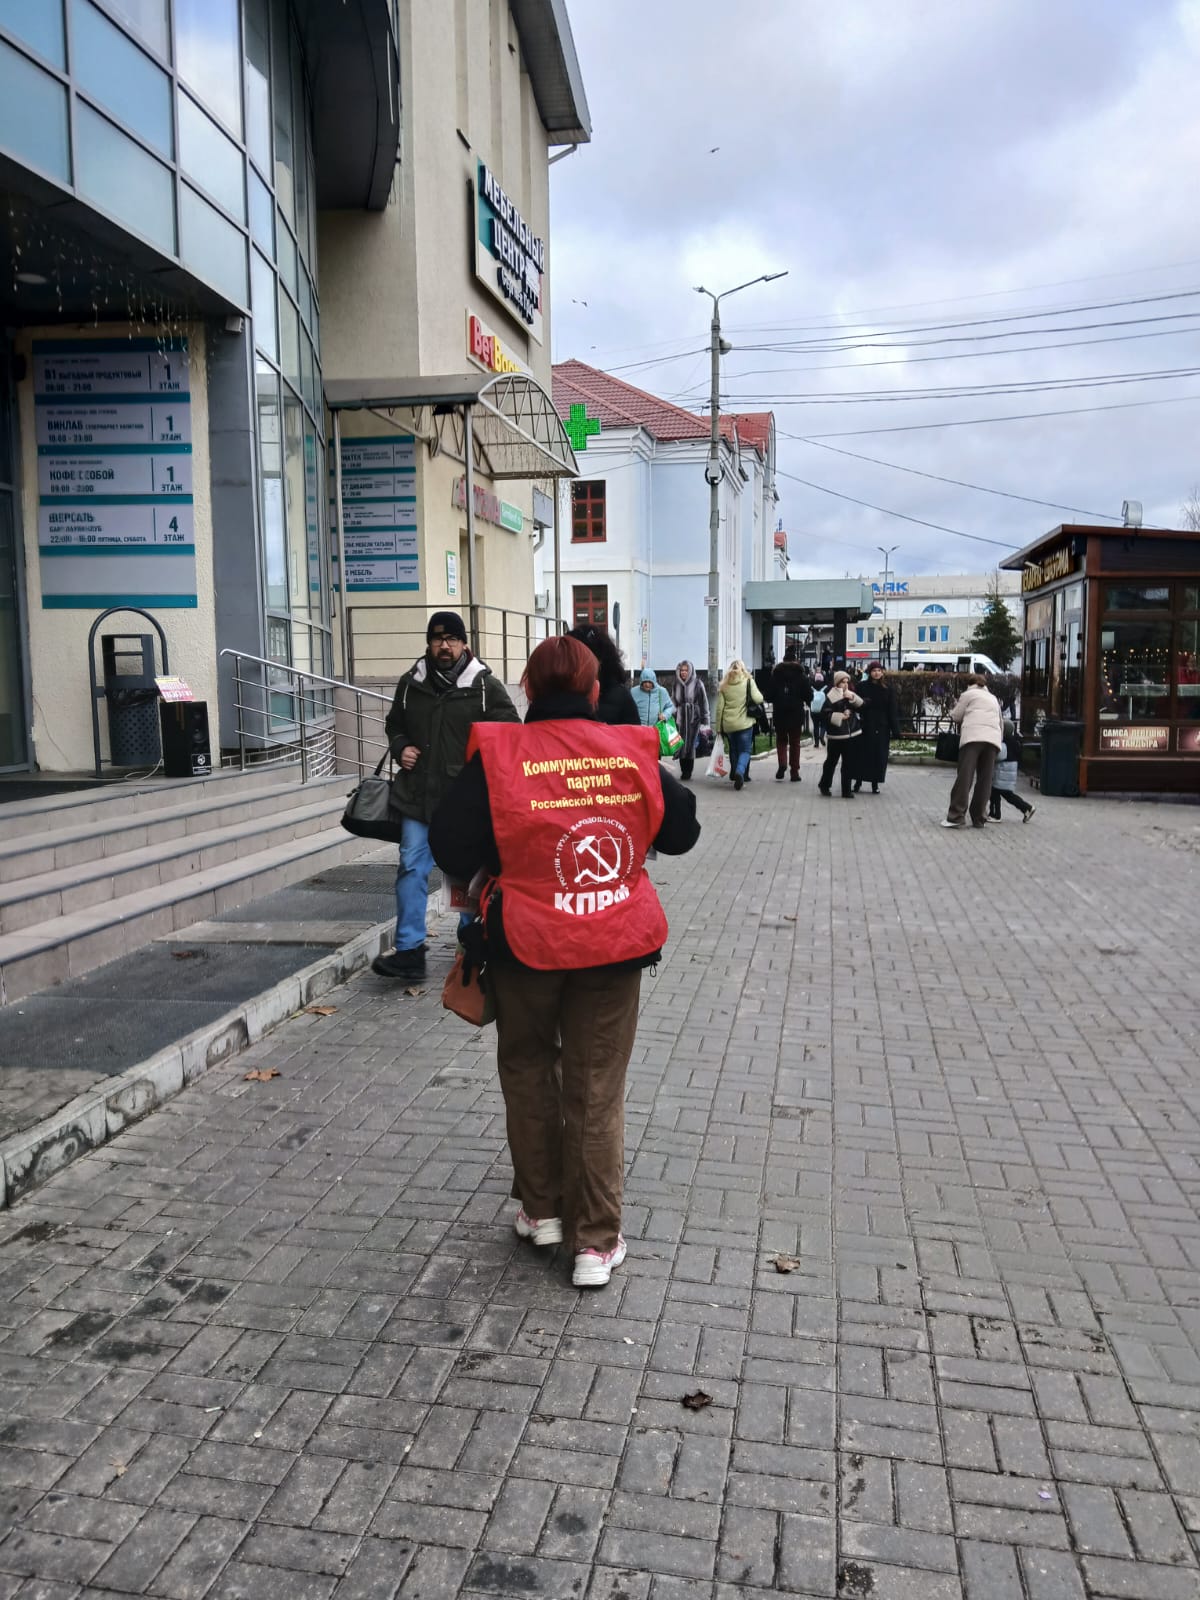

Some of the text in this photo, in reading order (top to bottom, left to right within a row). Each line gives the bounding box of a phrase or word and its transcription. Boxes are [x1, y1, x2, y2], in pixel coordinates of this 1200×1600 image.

[483, 164, 545, 272] МЕБЕЛЬНЫЙ
[493, 217, 527, 278] ЦЕНТР
[470, 315, 521, 373] BetBoo
[163, 363, 171, 381] 1
[158, 382, 180, 390] ЭТАЖ
[47, 420, 83, 431] ВИНЛАБ
[165, 415, 173, 432] 1
[160, 433, 182, 441] ЭТАЖ
[49, 469, 76, 480] КОФЕ
[85, 467, 115, 480] СОБОЙ
[166, 466, 174, 482] 1
[161, 484, 183, 492] ЭТАЖ
[458, 474, 500, 525] АТЕКА
[168, 516, 178, 532] 4
[163, 534, 185, 542] ЭТАЖ
[350, 568, 373, 576] МЕБЕЛЬ
[1103, 728, 1128, 737] САМСА
[1110, 739, 1158, 748] ИЗ ТАНДЫРА
[567, 773, 612, 792] партия
[530, 793, 594, 811] Российской
[554, 884, 630, 916] КПРФ
